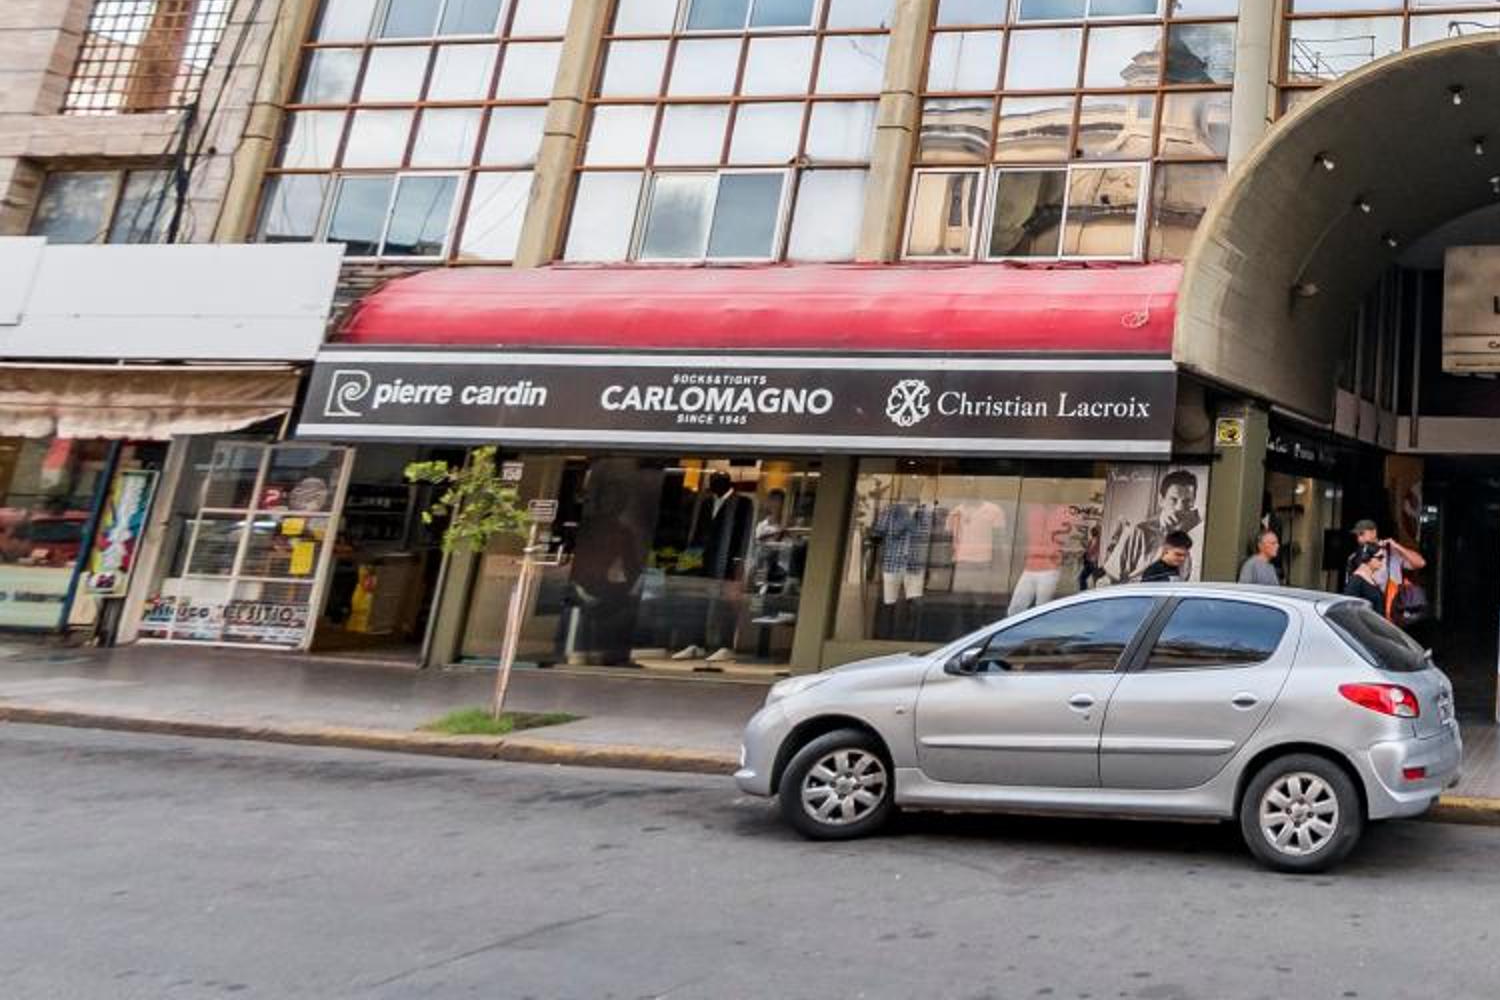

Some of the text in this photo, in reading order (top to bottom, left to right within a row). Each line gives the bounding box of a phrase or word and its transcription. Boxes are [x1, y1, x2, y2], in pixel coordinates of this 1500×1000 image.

[371, 378, 453, 409] pierre
[460, 380, 548, 407] cardin
[601, 385, 834, 415] CARLOMAGNO
[937, 391, 1048, 417] Christian
[1057, 392, 1151, 417] Lacroix
[676, 413, 714, 425] SINCE
